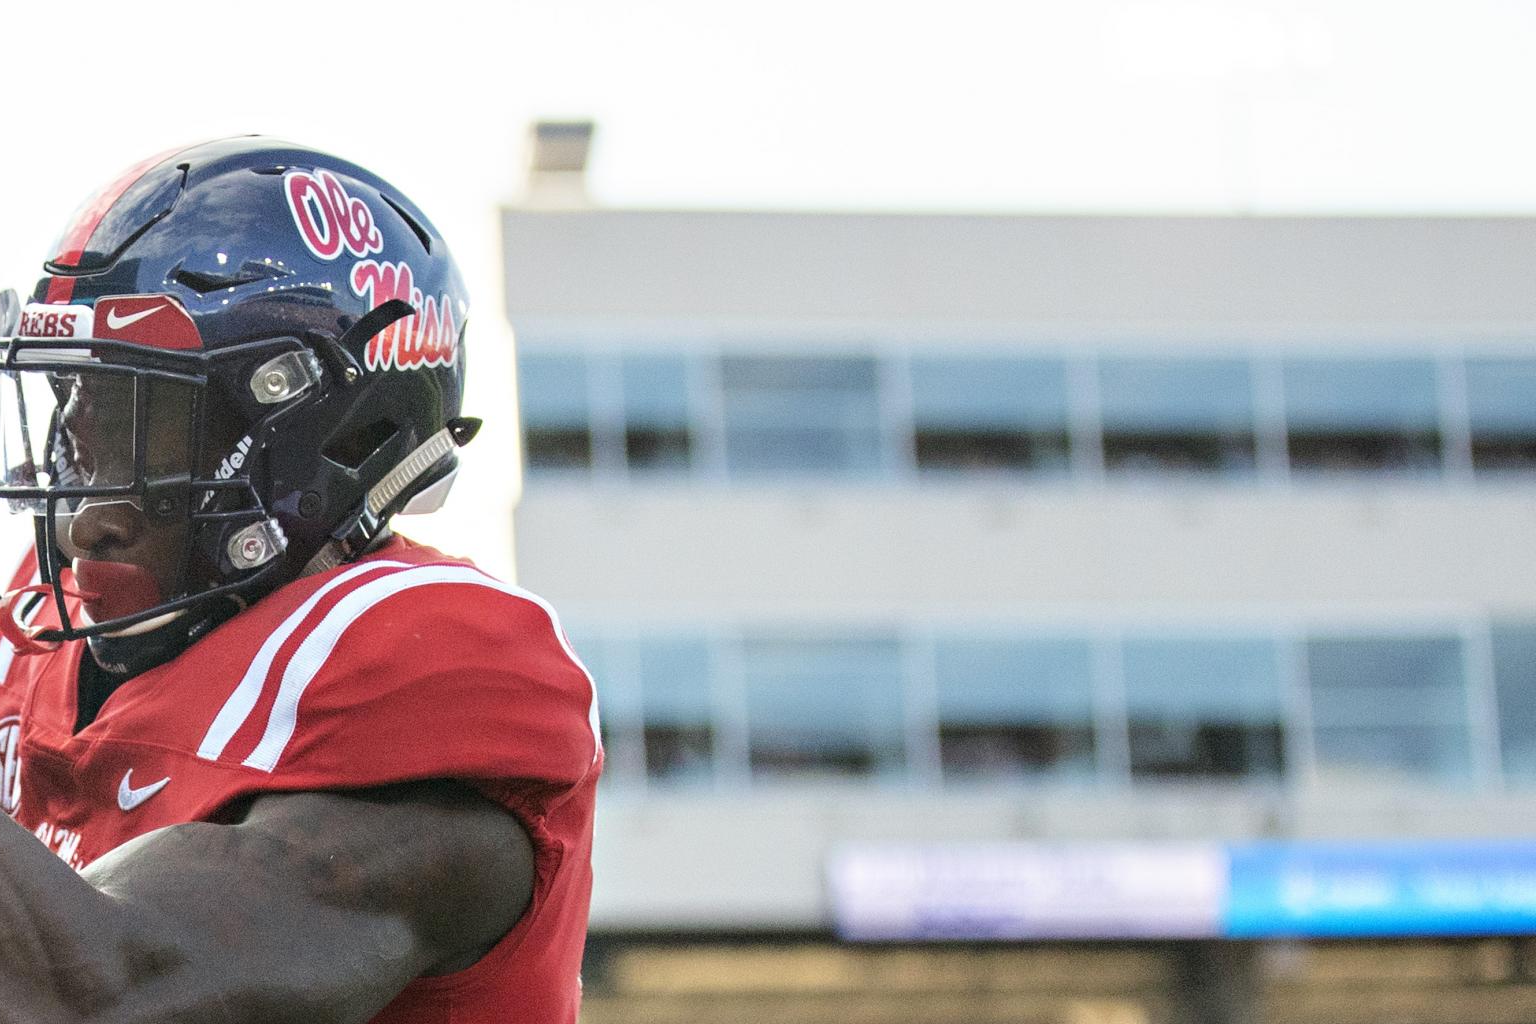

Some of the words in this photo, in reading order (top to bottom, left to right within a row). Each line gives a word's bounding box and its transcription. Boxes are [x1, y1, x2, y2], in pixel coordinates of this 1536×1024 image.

[284, 170, 384, 260] Ole
[17, 310, 78, 337] REBS
[350, 259, 458, 372] Miss
